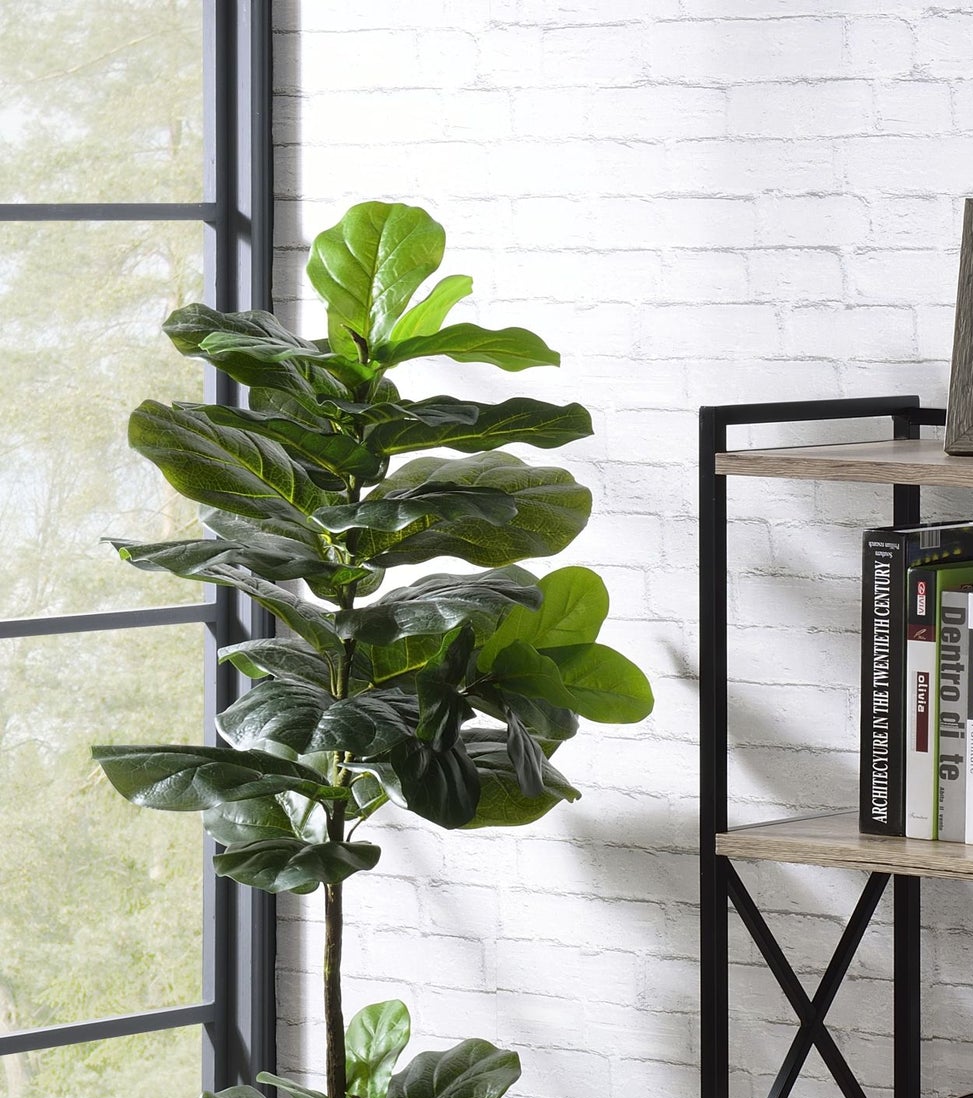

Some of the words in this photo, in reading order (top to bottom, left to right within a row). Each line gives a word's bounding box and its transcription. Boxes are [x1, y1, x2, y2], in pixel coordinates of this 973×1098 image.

[874, 560, 891, 617] CENTURY
[873, 619, 890, 688] TWENTIETH
[940, 606, 966, 702] Dentro
[873, 690, 889, 714] THE
[918, 675, 928, 713] olivia
[873, 717, 889, 730] IN
[940, 711, 965, 739] di
[872, 731, 889, 824] ARCHITECYURE
[939, 754, 964, 781] te
